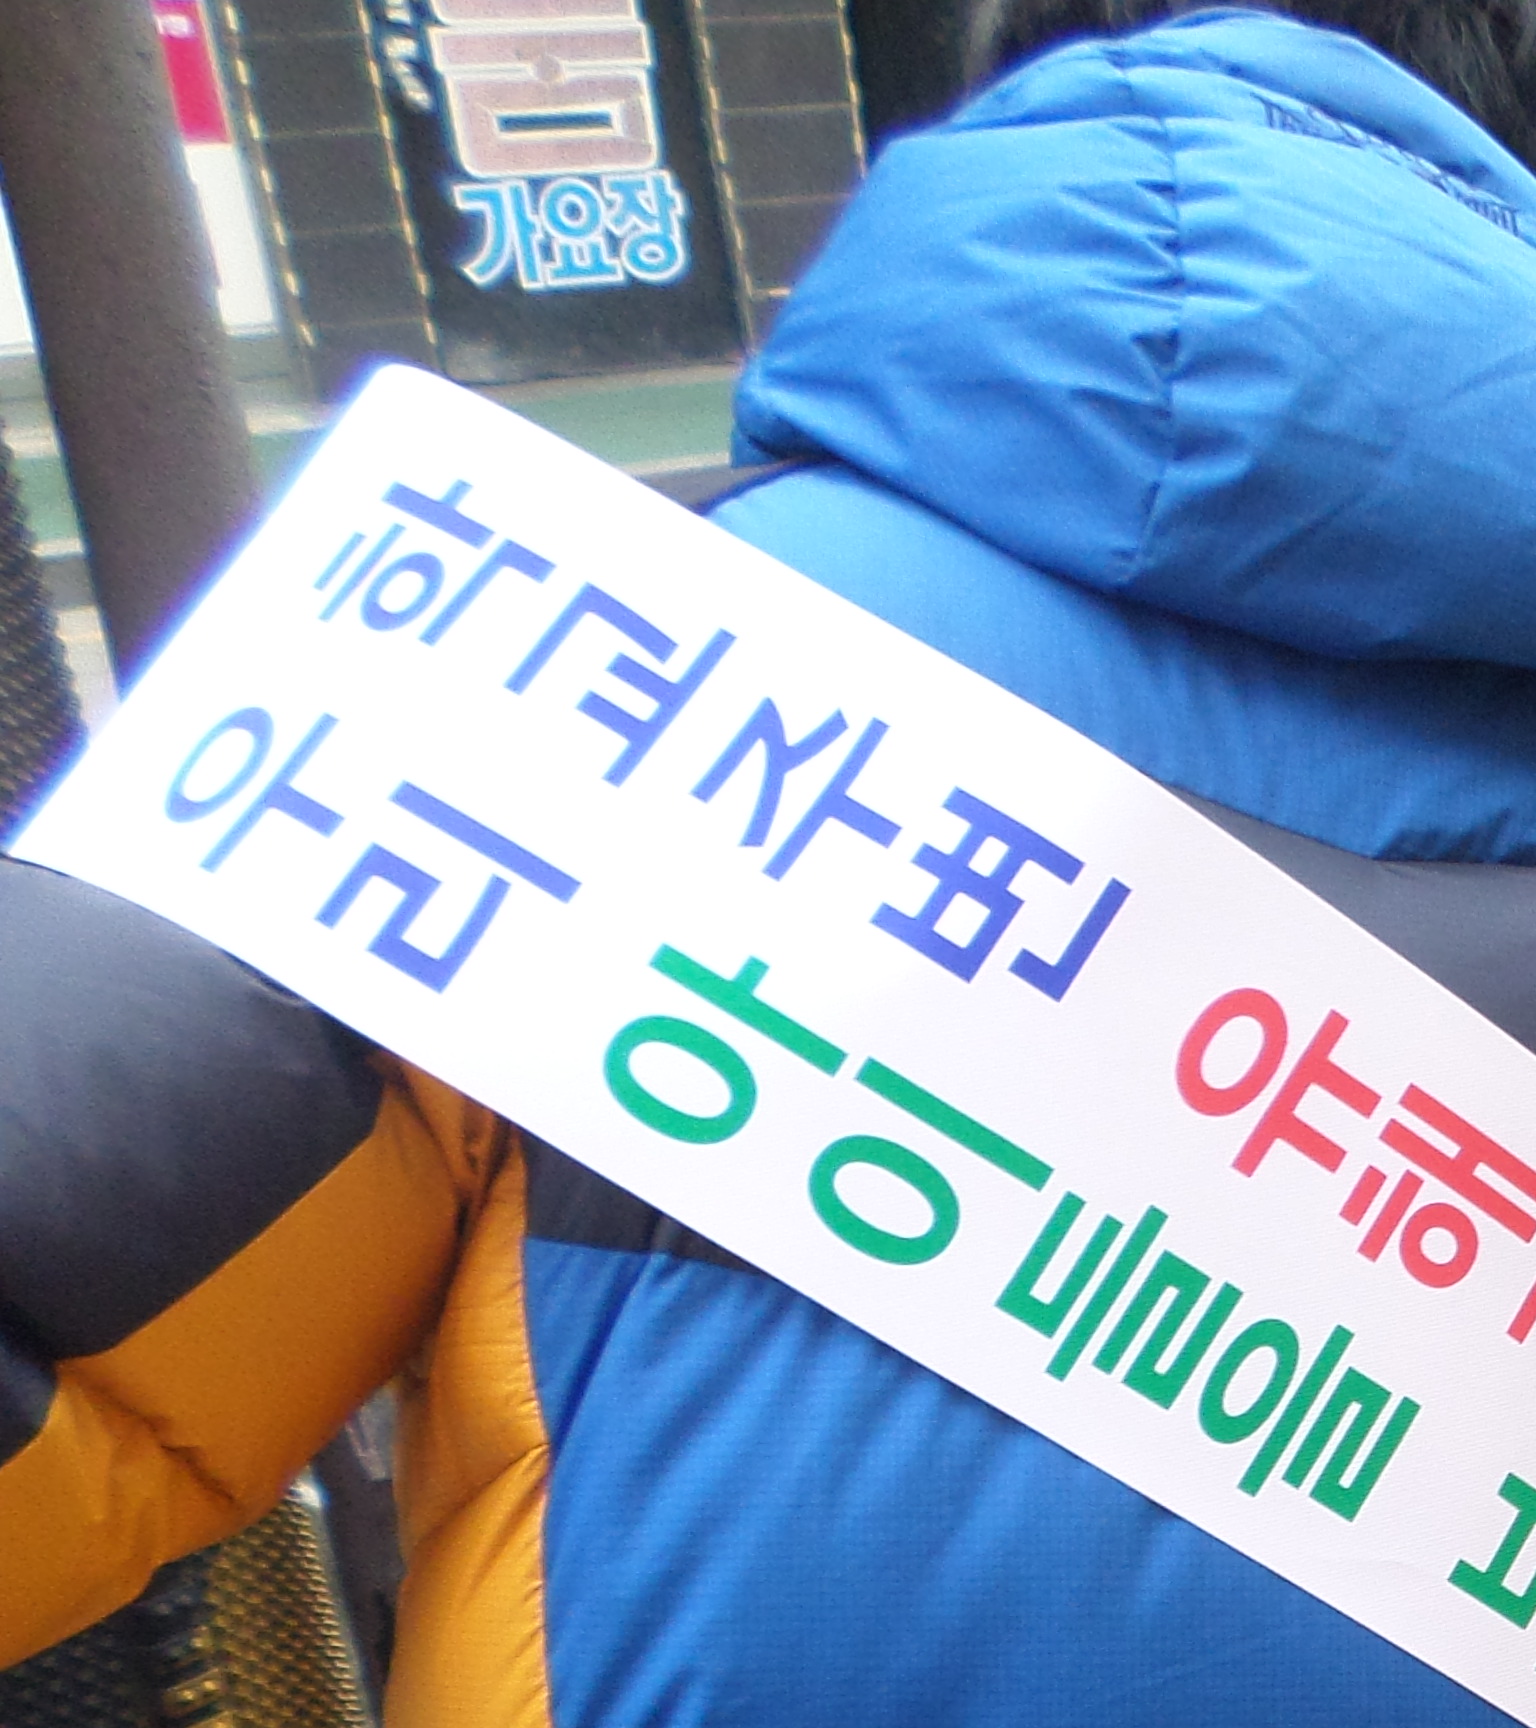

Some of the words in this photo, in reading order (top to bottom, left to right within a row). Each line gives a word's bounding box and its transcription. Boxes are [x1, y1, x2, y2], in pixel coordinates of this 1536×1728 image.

[453, 171, 689, 291] 가요장
[312, 479, 1133, 1003] 학교주변
[164, 706, 583, 995] 우리
[602, 942, 1421, 1523] 아이들을
